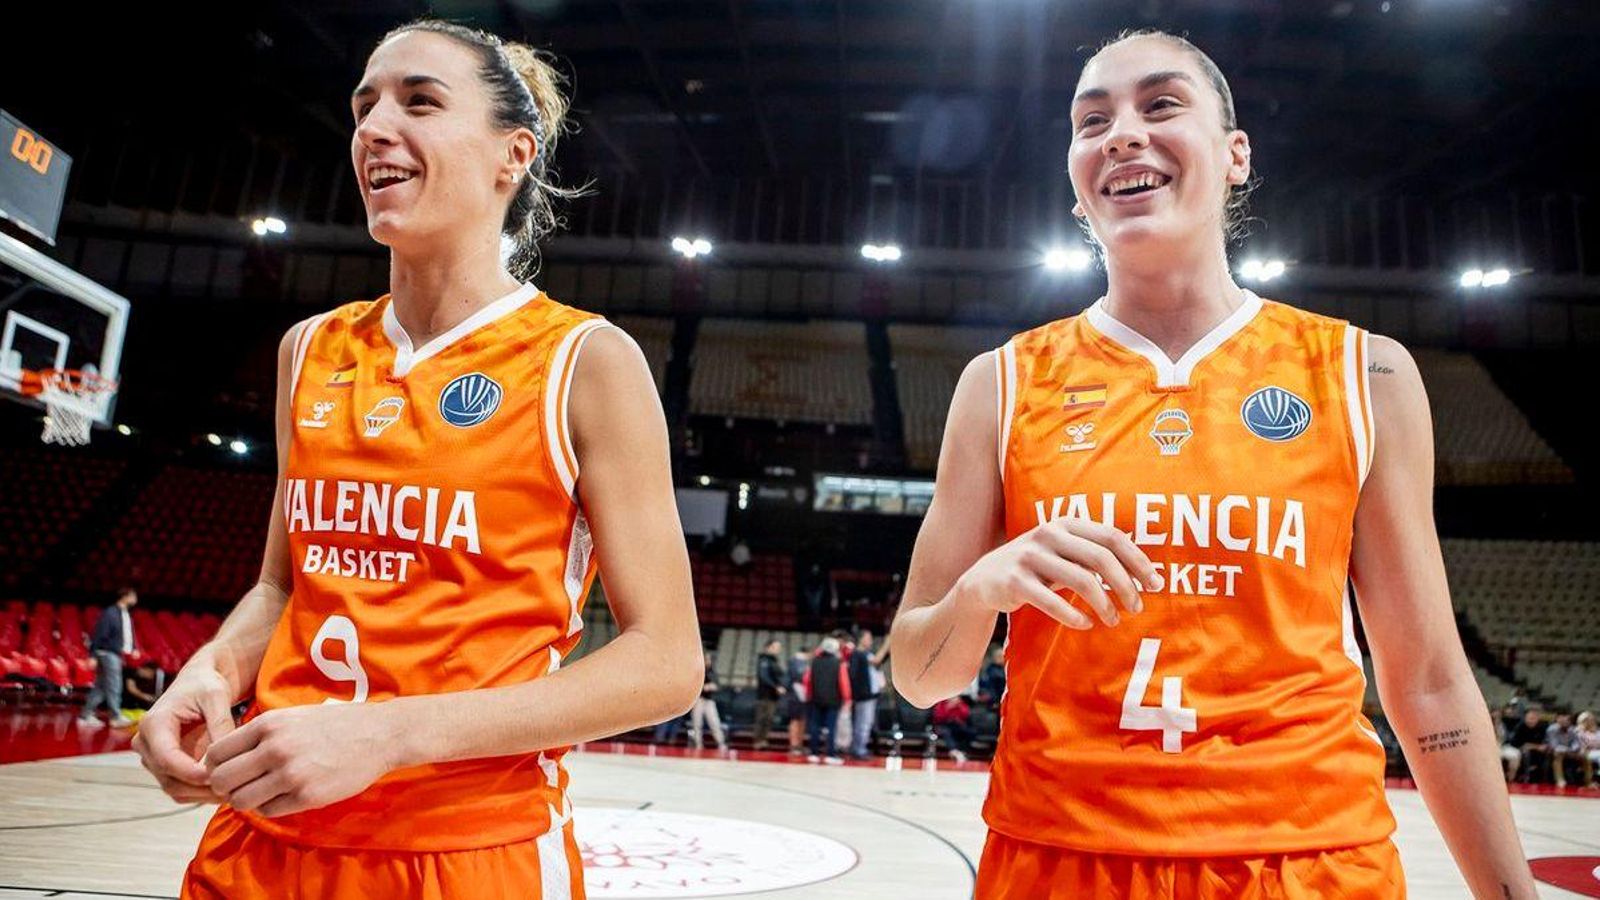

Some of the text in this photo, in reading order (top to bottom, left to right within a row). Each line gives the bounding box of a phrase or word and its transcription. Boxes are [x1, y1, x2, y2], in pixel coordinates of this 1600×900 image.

[11, 127, 54, 175] 00
[302, 544, 416, 583] BASKET
[1095, 562, 1243, 597] SKET
[310, 614, 369, 704] 9
[1119, 638, 1197, 753] 4
